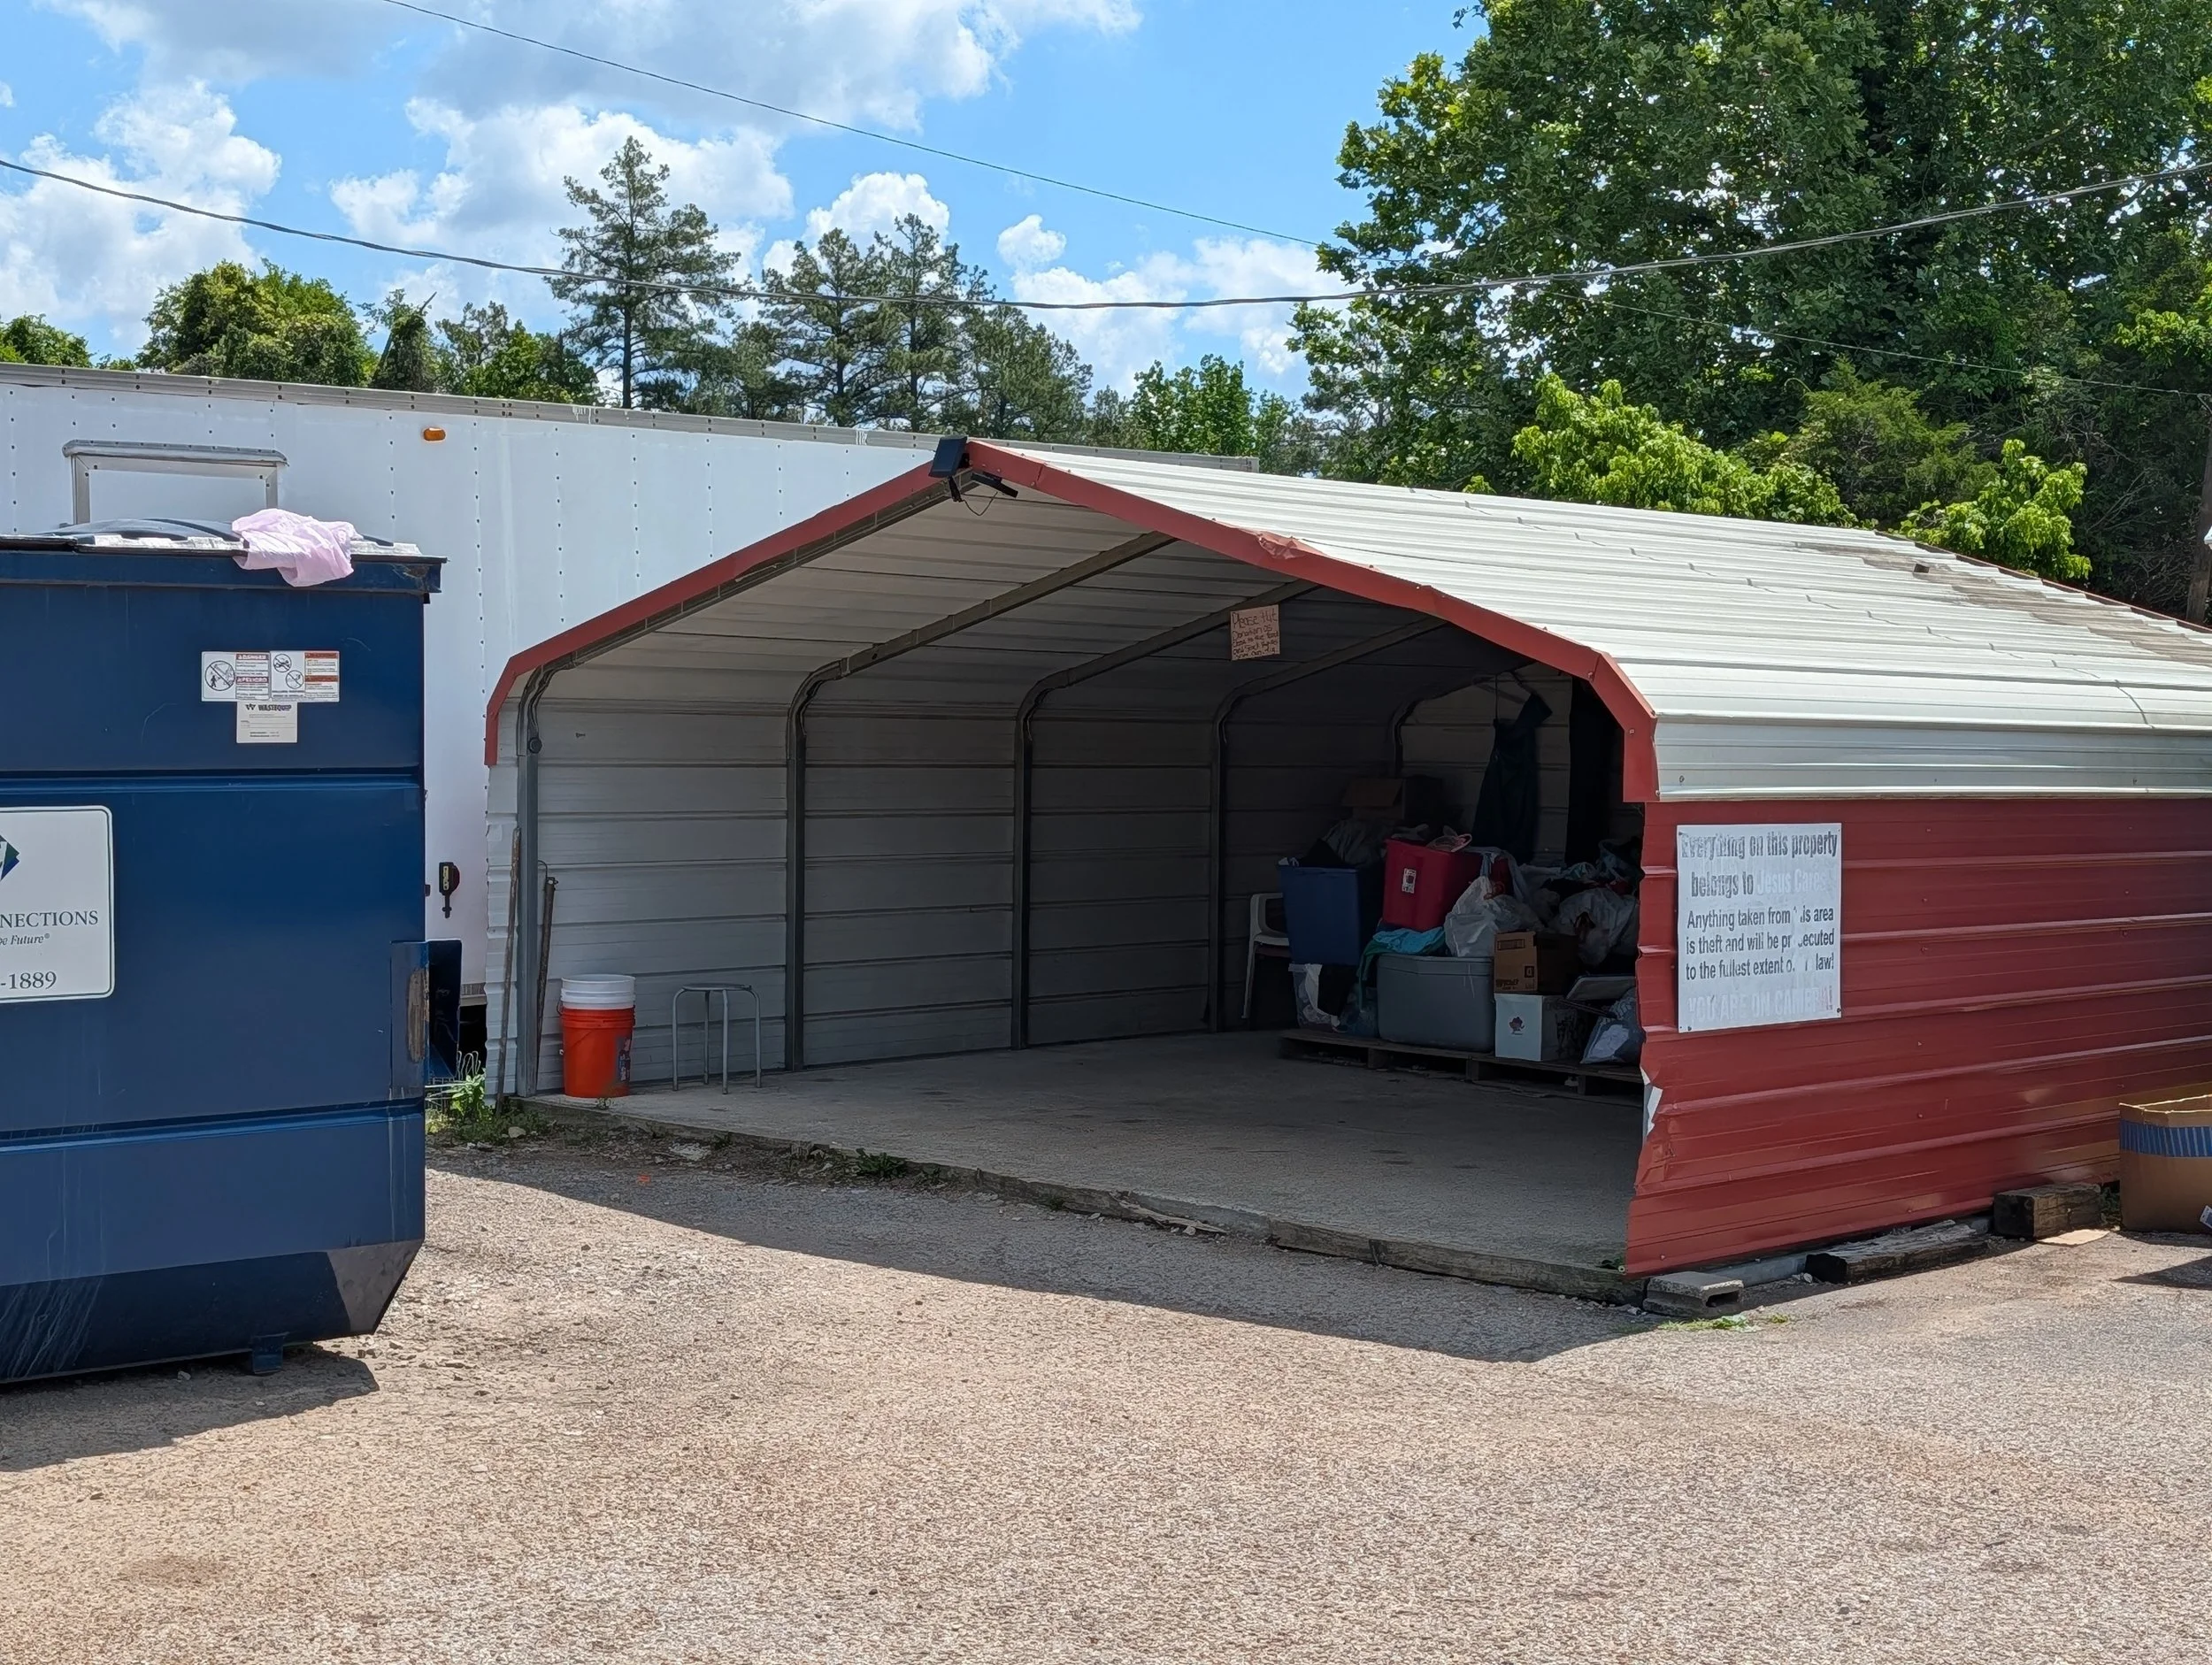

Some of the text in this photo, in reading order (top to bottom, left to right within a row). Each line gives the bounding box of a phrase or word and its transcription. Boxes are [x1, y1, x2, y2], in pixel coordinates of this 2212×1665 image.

[1749, 834, 1763, 857] on
[1767, 832, 1788, 856] this
[1792, 832, 1838, 858] property
[1692, 871, 1740, 898] belongs
[1742, 871, 1754, 895] to
[1687, 909, 1735, 932] Anything
[1738, 908, 1765, 926] taken
[1768, 906, 1791, 925] from
[1814, 908, 1834, 922] area
[1686, 928, 1835, 955] is theft and will be precuted
[1686, 963, 1696, 980] to
[1700, 961, 1717, 979] the
[1719, 958, 1751, 978] fullest
[1753, 956, 1784, 976] extent
[1786, 958, 1795, 973] o
